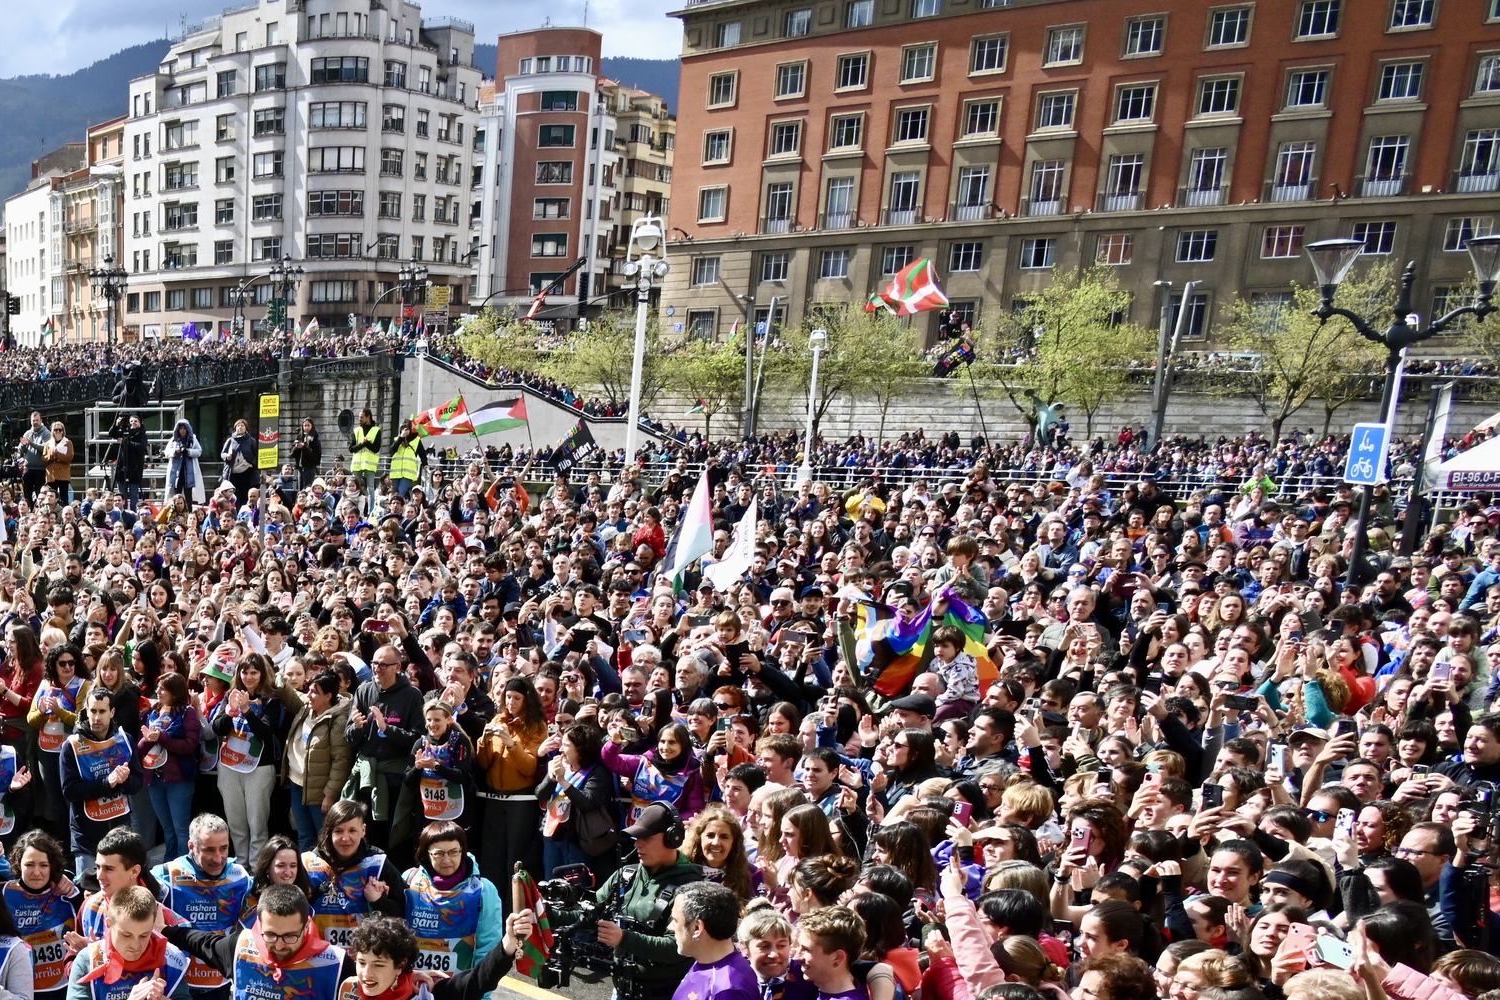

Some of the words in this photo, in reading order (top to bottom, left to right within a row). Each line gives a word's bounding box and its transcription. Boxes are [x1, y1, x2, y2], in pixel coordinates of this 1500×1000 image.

[424, 788, 446, 801] 3148
[186, 904, 218, 912] Euskara
[190, 910, 218, 924] gara
[411, 910, 439, 920] Euskara
[412, 917, 439, 928] gara
[330, 930, 354, 946] 343
[33, 943, 62, 964] 3436
[318, 952, 336, 960] eitb
[168, 954, 184, 966] eitb
[416, 952, 450, 972] 3436
[34, 968, 62, 979] orrika
[106, 992, 130, 1000] Eusk
[245, 984, 281, 1000] Euskara
